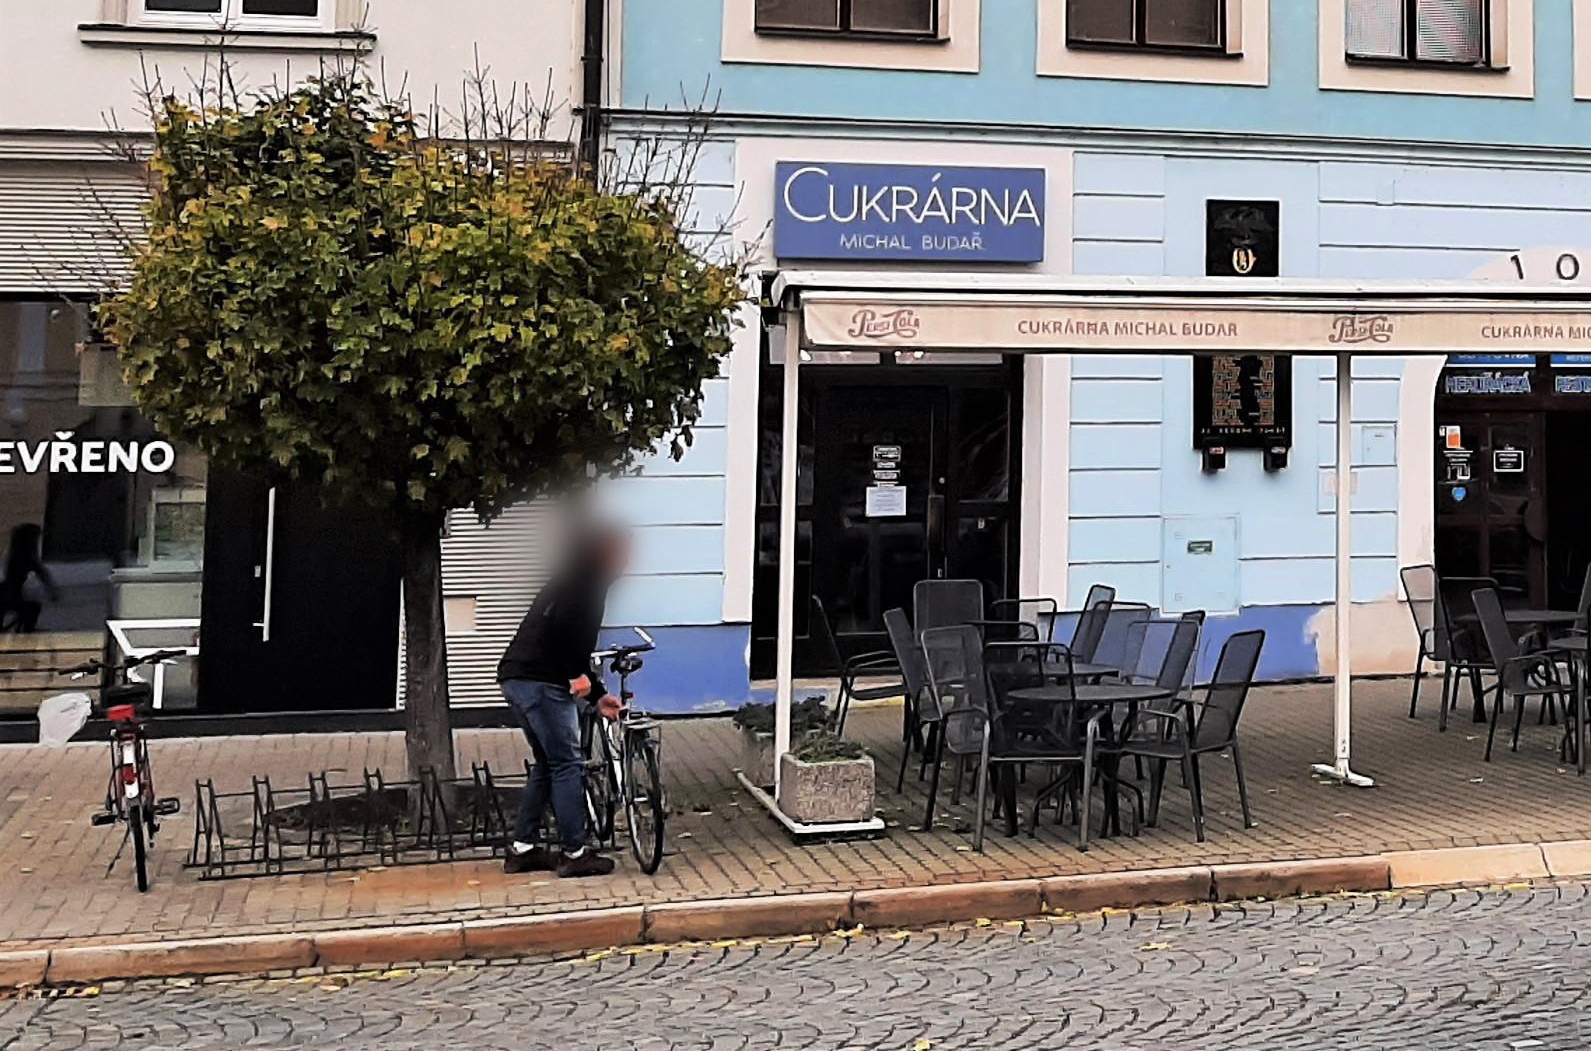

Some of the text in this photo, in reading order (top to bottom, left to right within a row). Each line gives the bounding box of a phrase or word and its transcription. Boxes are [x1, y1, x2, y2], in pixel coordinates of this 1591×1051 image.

[784, 167, 1041, 227] CUKRÁRNA
[840, 231, 983, 250] MICHAL BUDAŘ
[1114, 321, 1177, 336] MICHAL
[0, 430, 175, 473] EVŘENO
